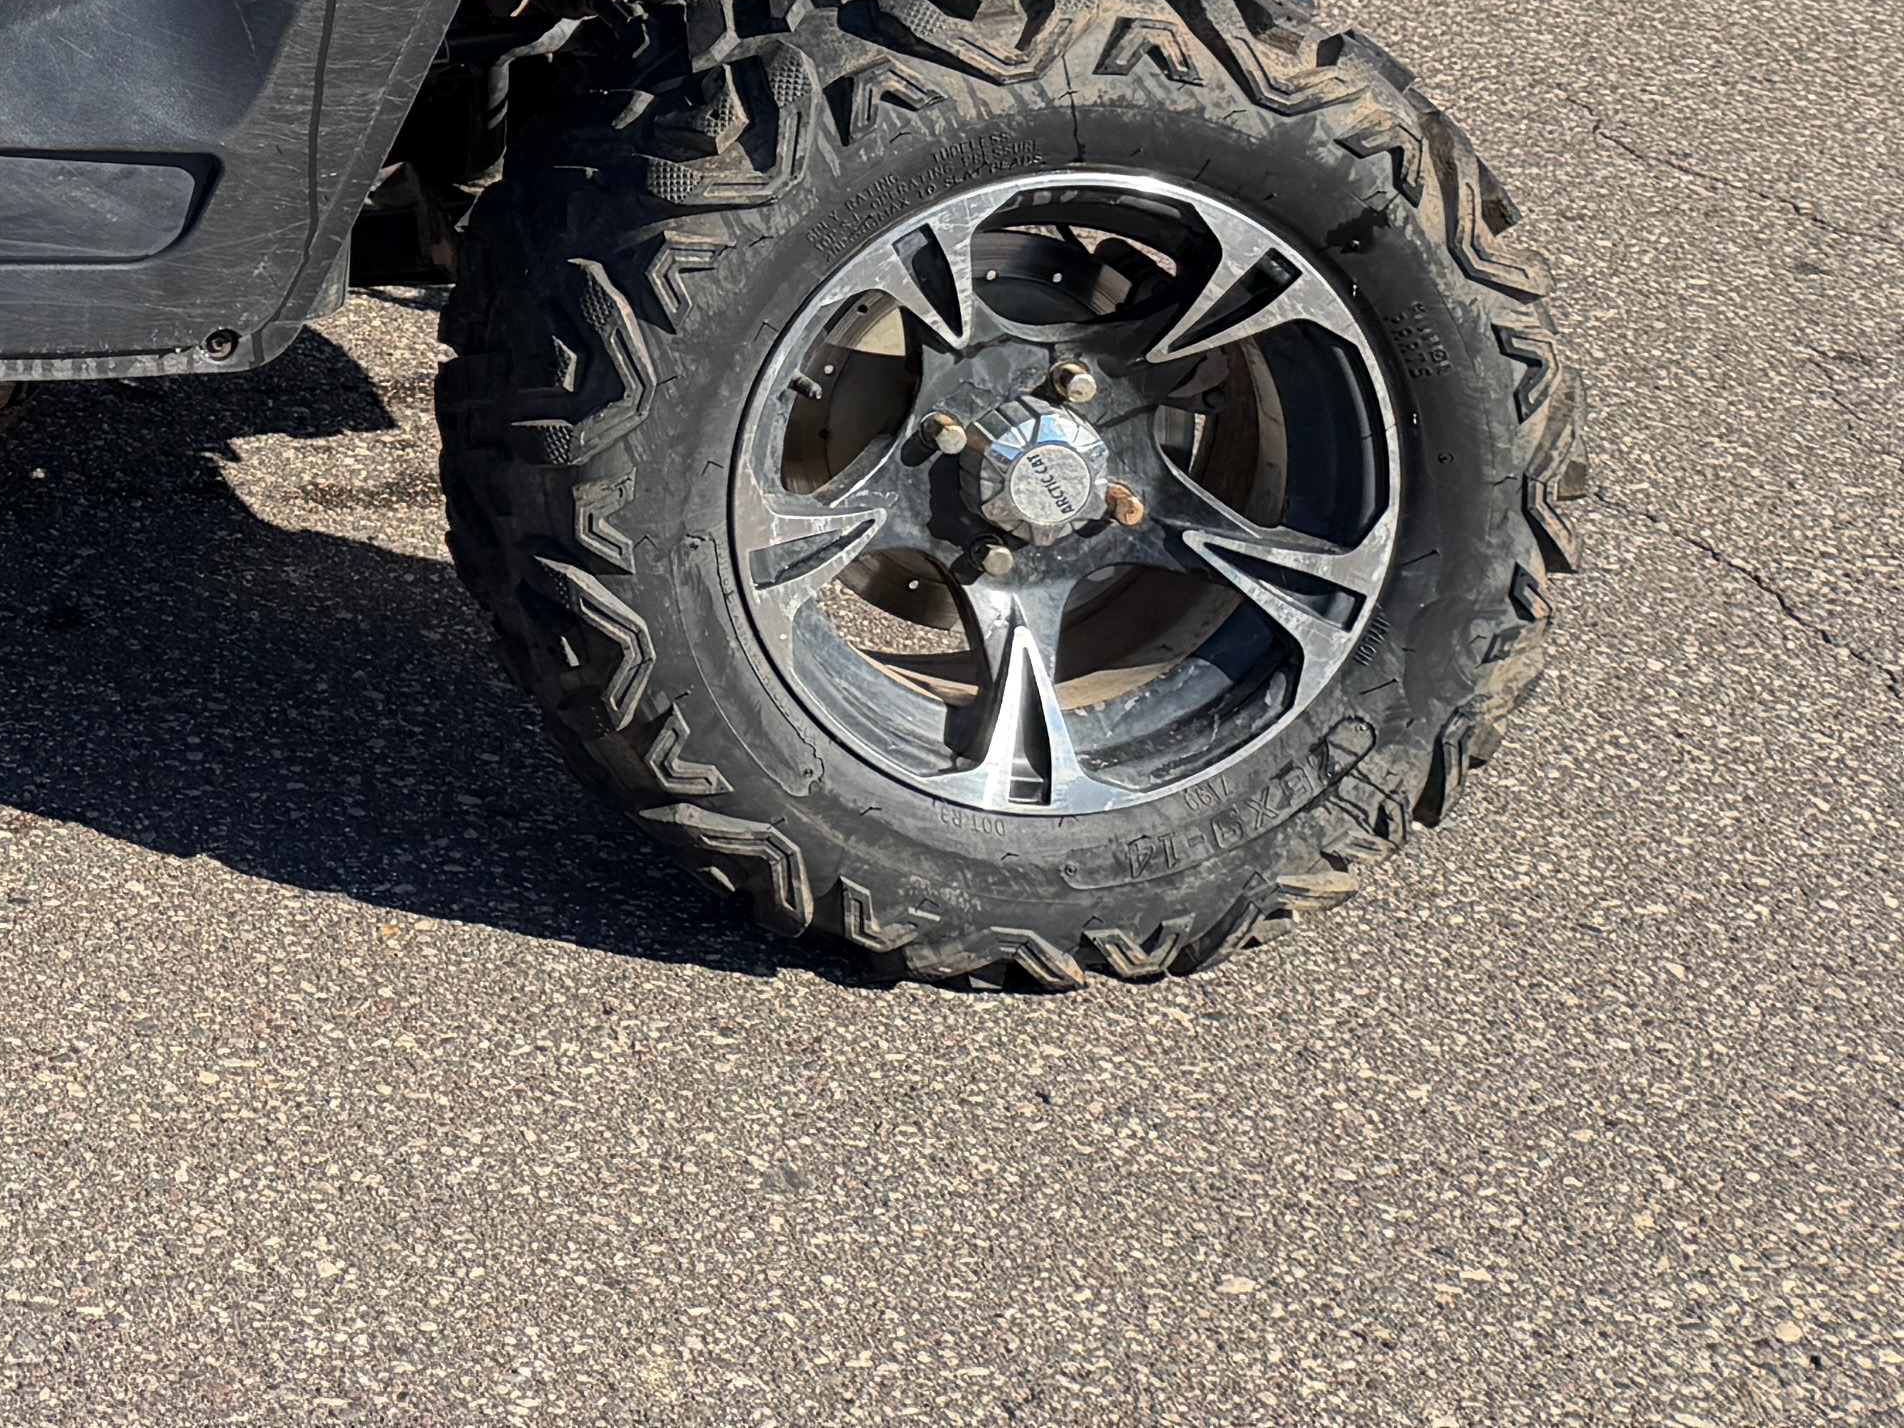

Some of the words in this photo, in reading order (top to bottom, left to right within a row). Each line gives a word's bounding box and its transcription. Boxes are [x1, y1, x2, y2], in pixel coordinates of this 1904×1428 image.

[844, 173, 900, 212] RATING
[1026, 454, 1048, 474] CAT
[1041, 474, 1075, 515] ARCTIC
[1351, 615, 1392, 668] NYLON
[967, 812, 1007, 838] DOT
